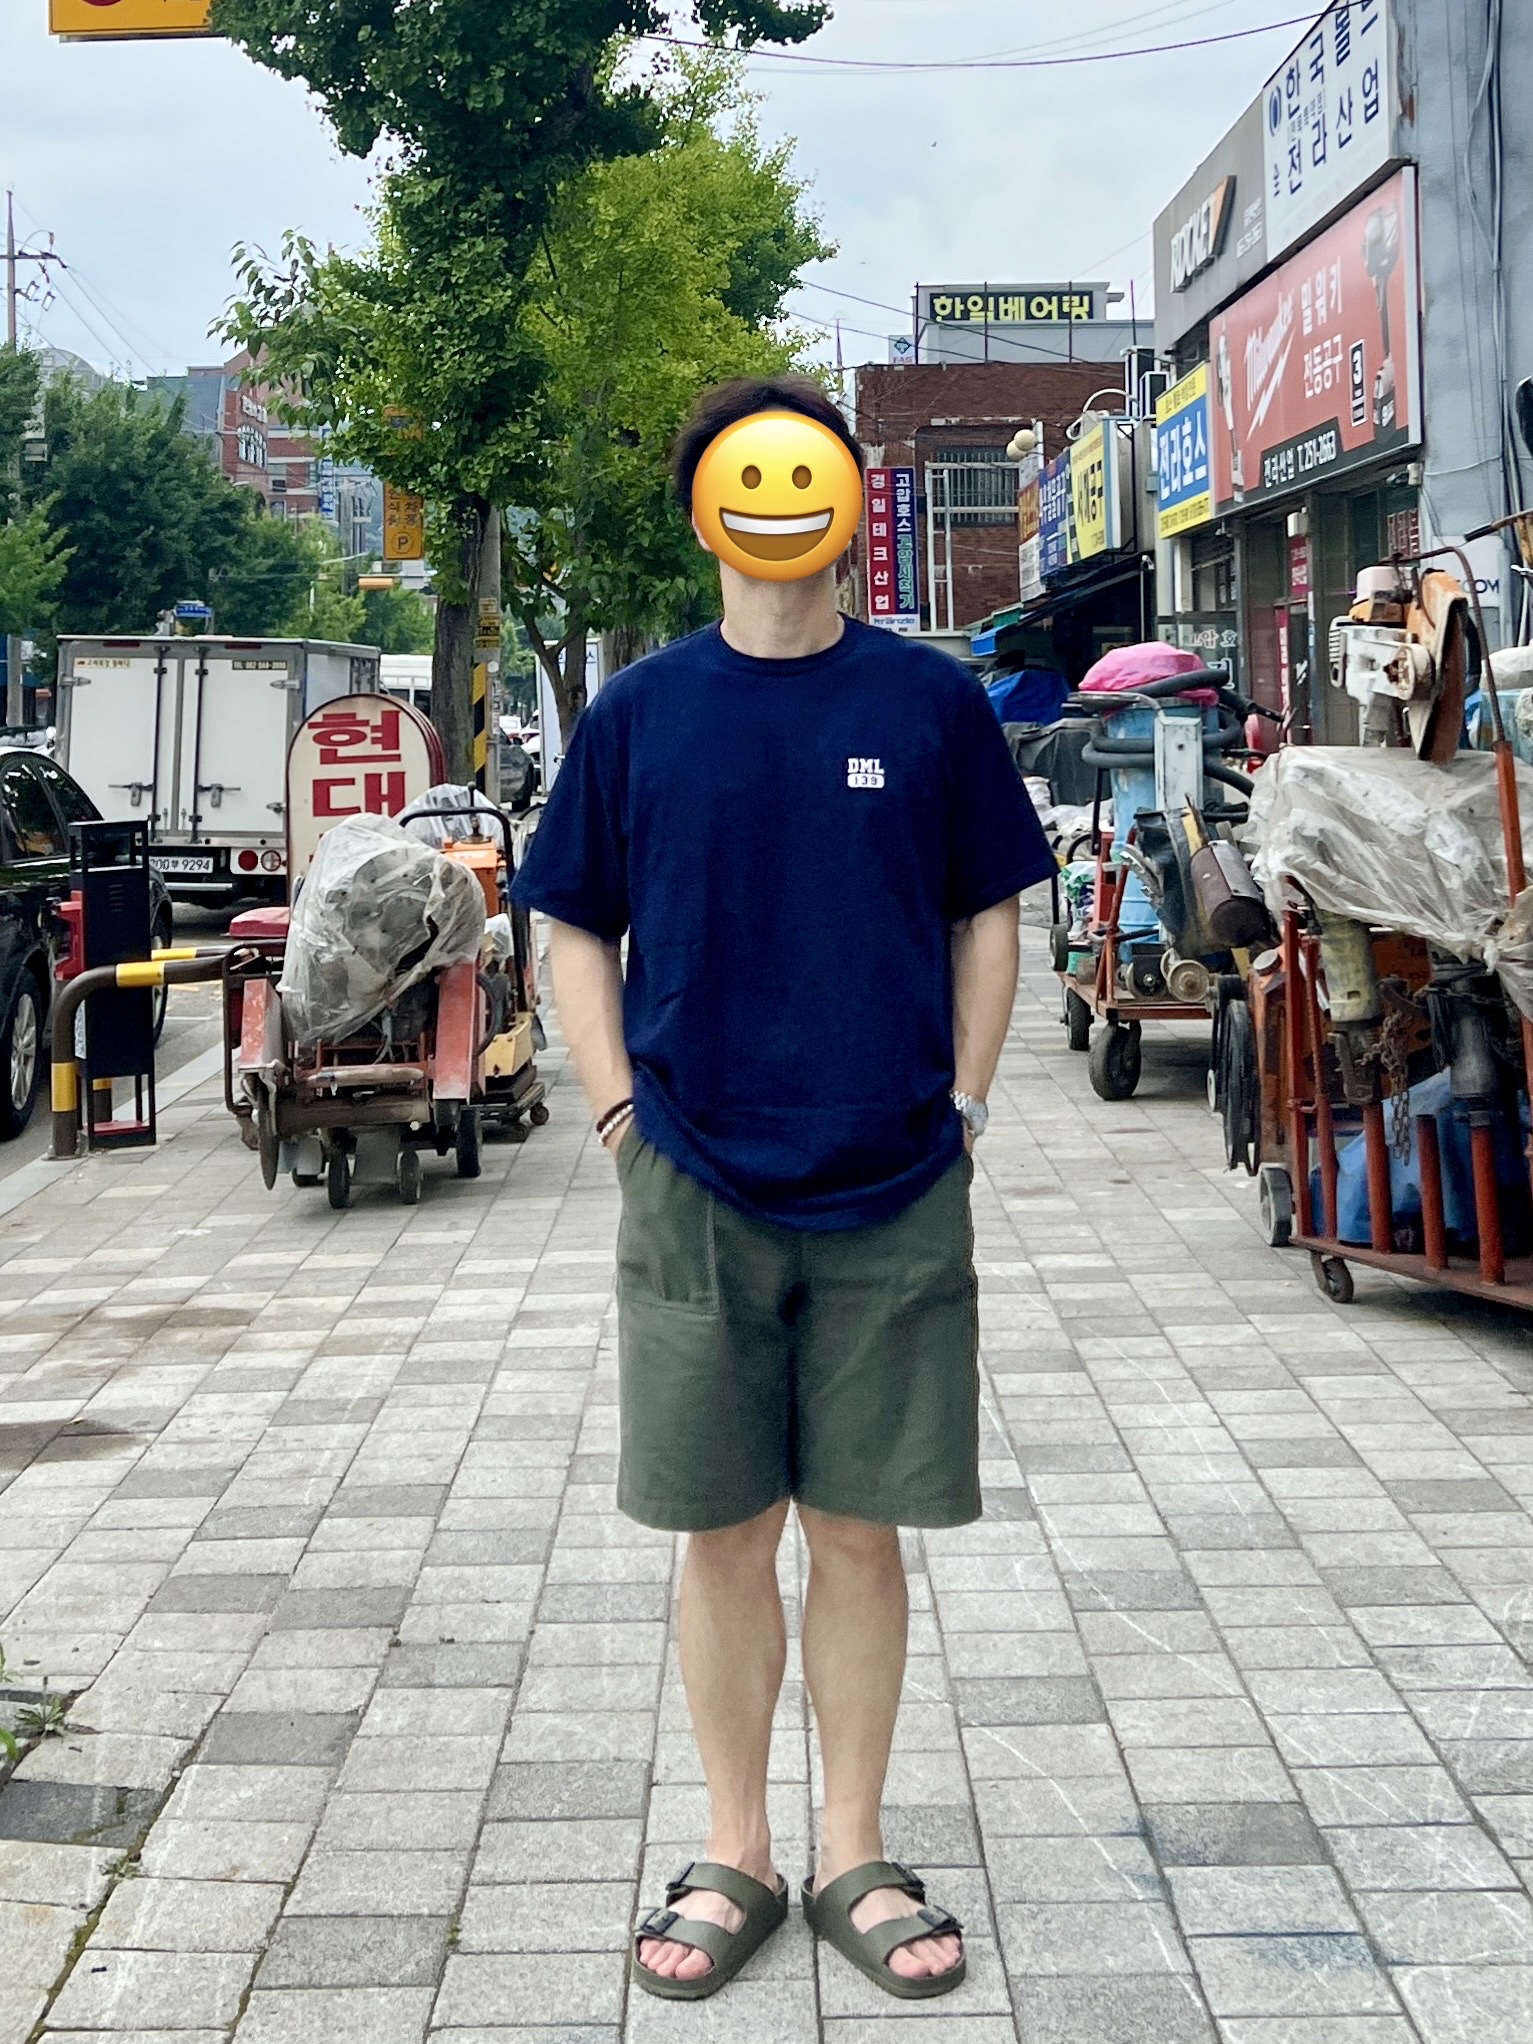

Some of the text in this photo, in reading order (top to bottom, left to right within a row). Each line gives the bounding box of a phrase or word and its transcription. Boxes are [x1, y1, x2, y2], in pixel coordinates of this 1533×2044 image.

[1287, 59, 1379, 195] 전라산업
[933, 295, 1090, 321] 한일베어링
[1301, 256, 1343, 336] 밀워키
[1304, 334, 1343, 398] 전동공구
[1353, 351, 1362, 385] 3
[1159, 411, 1207, 500] 전라호스
[1264, 448, 1295, 488] 전라산업
[895, 473, 912, 532] 고압호스
[871, 474, 889, 610] 경일테크산업
[847, 758, 885, 774] DML
[855, 776, 877, 786] 139
[182, 859, 210, 870] 9294
